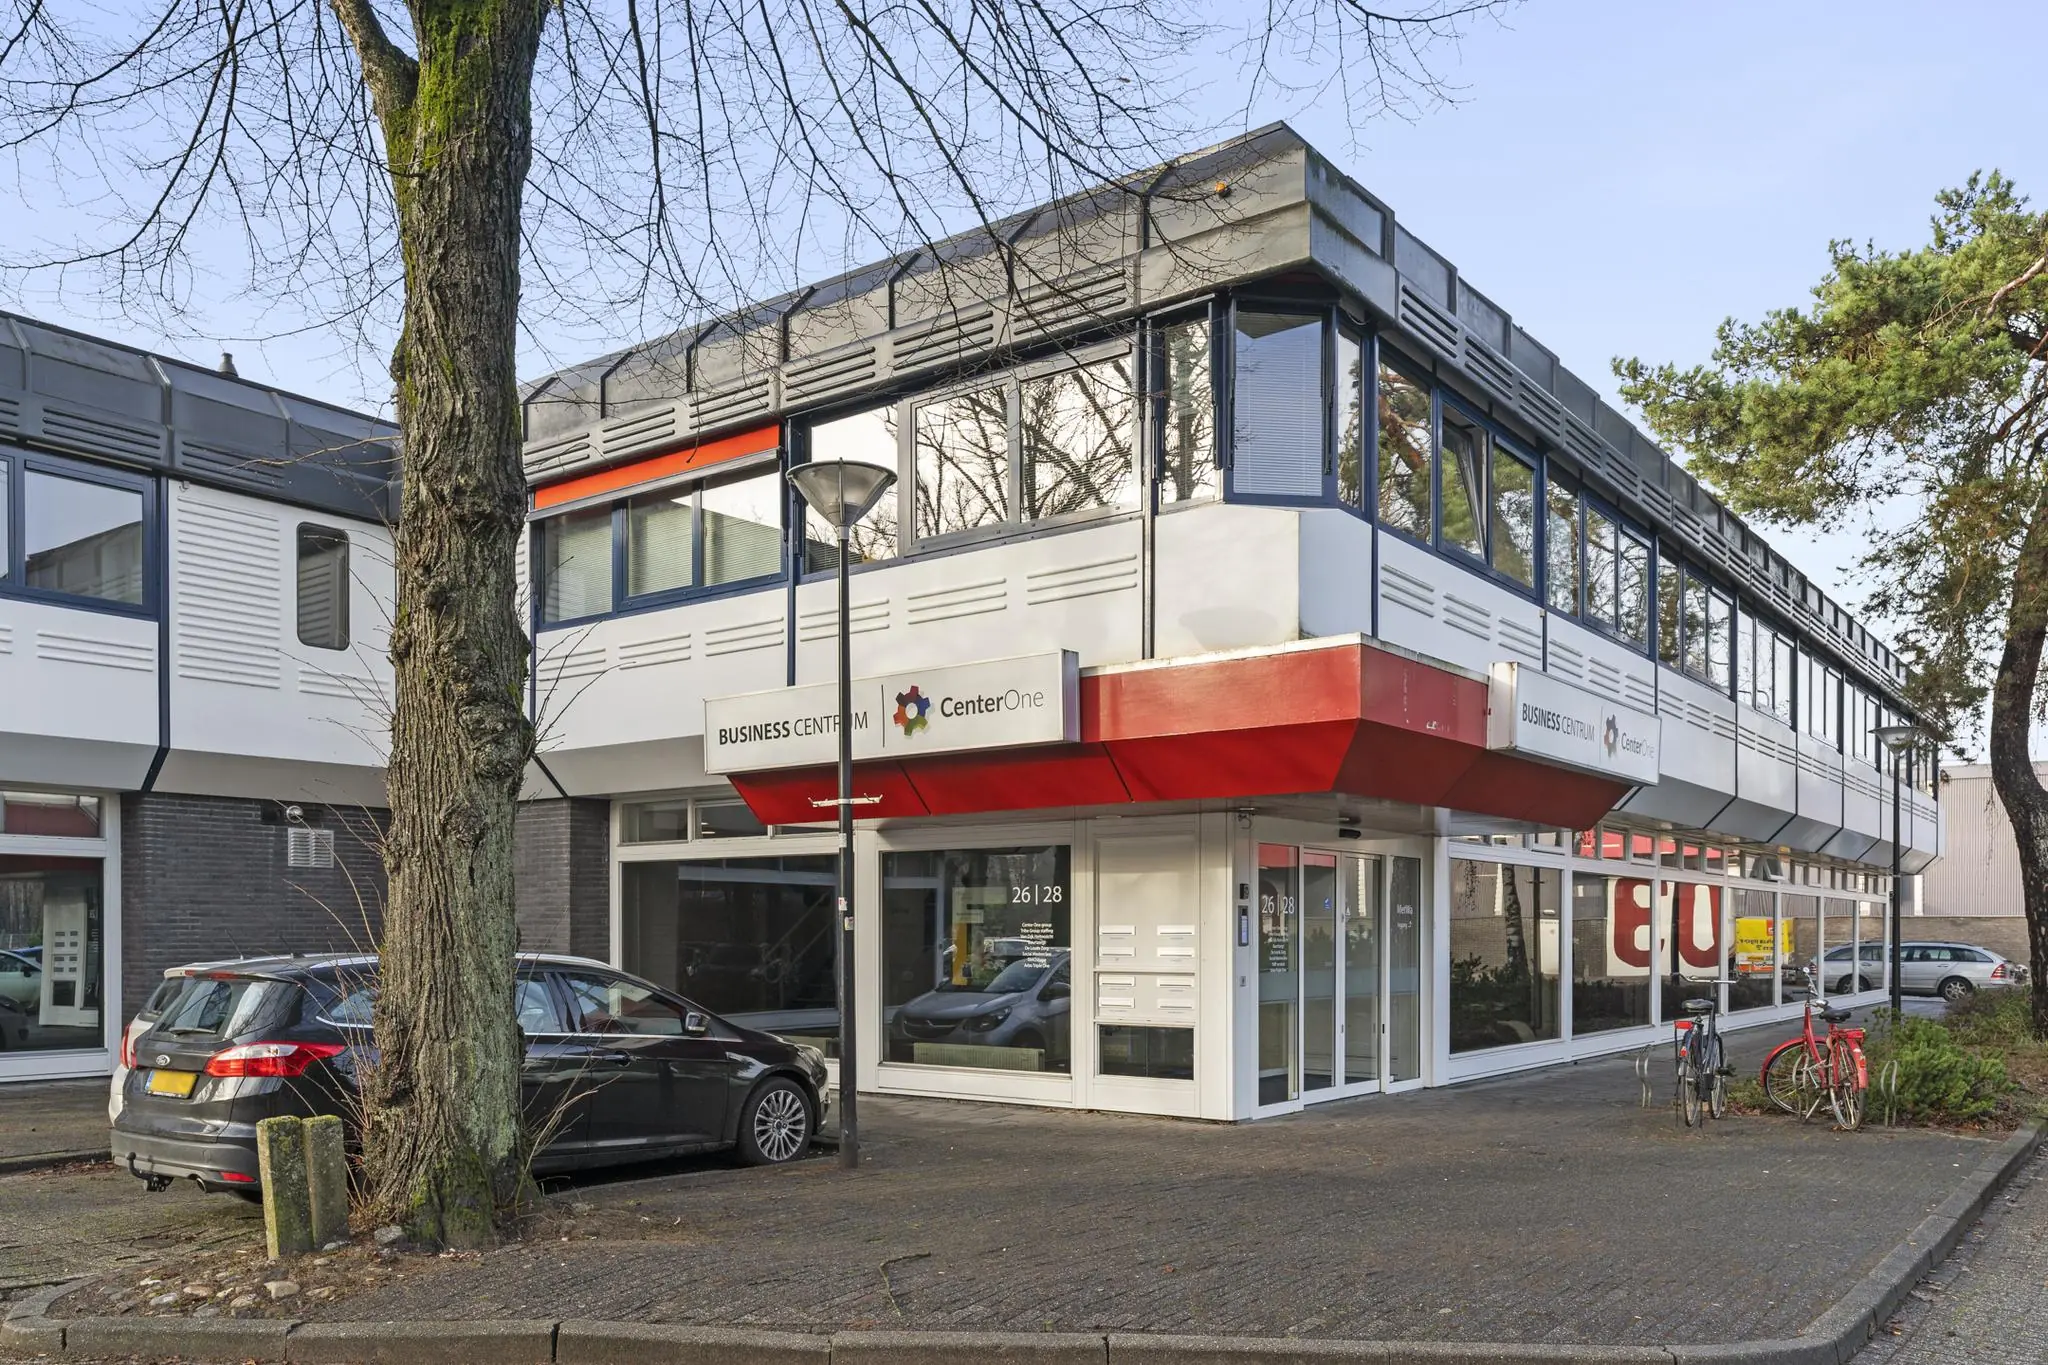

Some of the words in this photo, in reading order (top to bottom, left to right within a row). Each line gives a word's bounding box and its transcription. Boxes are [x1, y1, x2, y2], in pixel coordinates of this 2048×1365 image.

[940, 688, 1044, 718] CenterOne
[719, 720, 790, 745] BUSINESS
[794, 711, 868, 737] CENTRM
[1522, 703, 1561, 732] BUSINESS
[1561, 716, 1595, 742] CENTRUM
[1621, 732, 1655, 759] CenterOne
[1012, 886, 1031, 903] 26
[1043, 886, 1062, 903] 28
[1261, 895, 1275, 914] 26
[1282, 897, 1295, 914] 28
